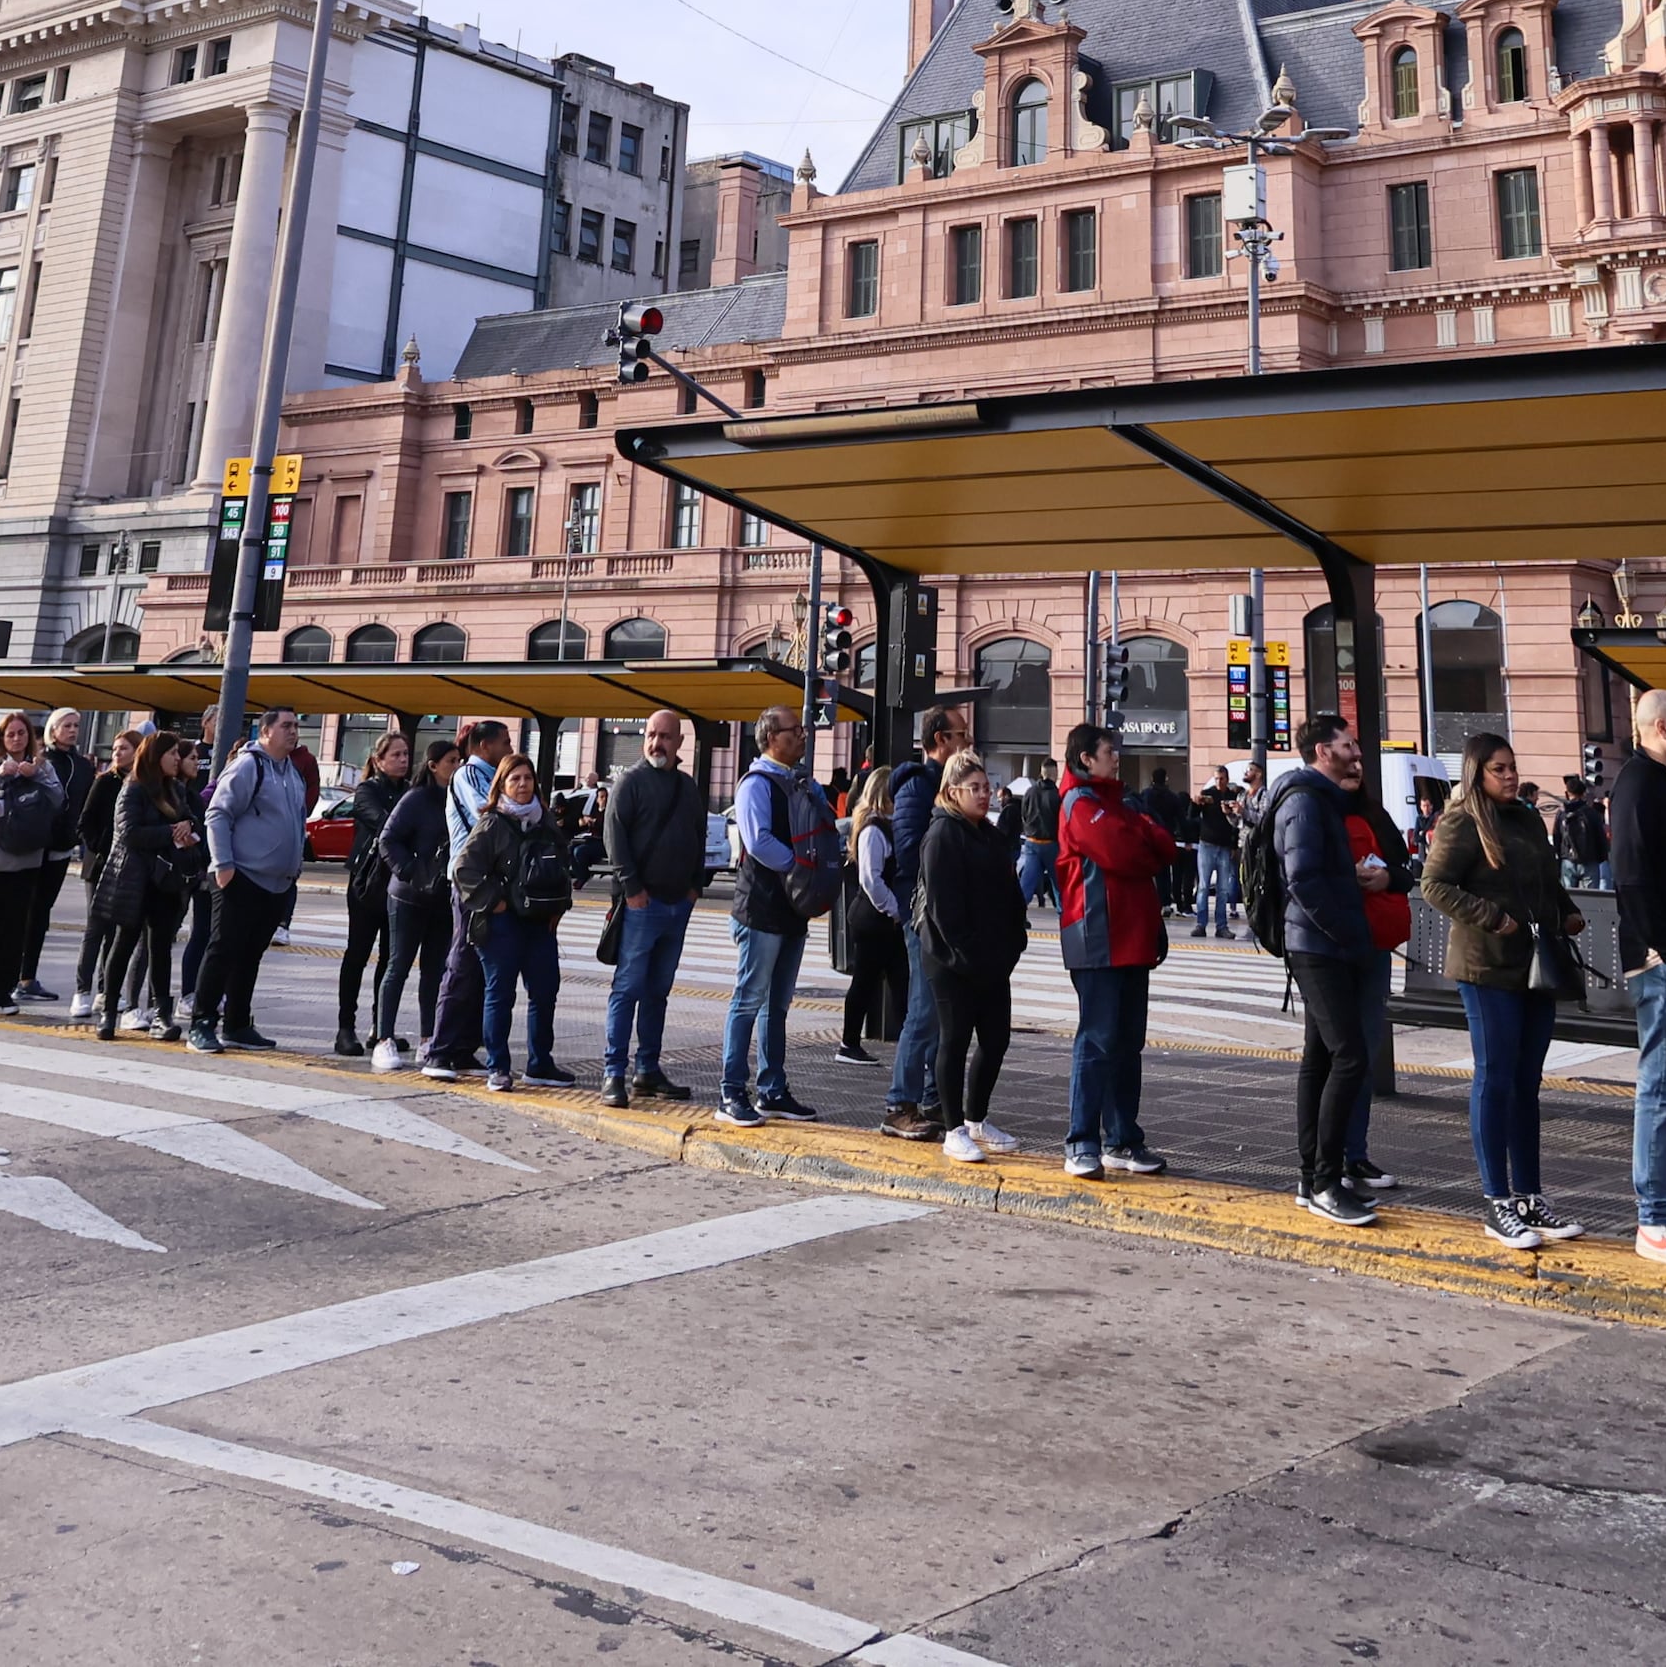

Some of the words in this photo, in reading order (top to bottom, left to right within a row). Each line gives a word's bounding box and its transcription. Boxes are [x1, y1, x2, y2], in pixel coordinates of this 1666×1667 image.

[894, 410, 970, 425] Constitución
[227, 507, 239, 519] 45
[274, 504, 290, 516] 100
[223, 527, 238, 539] 143
[273, 525, 285, 537] 59
[270, 546, 281, 559] 91
[270, 567, 276, 578] 9
[1338, 679, 1355, 691] 100
[1231, 711, 1245, 720] 100
